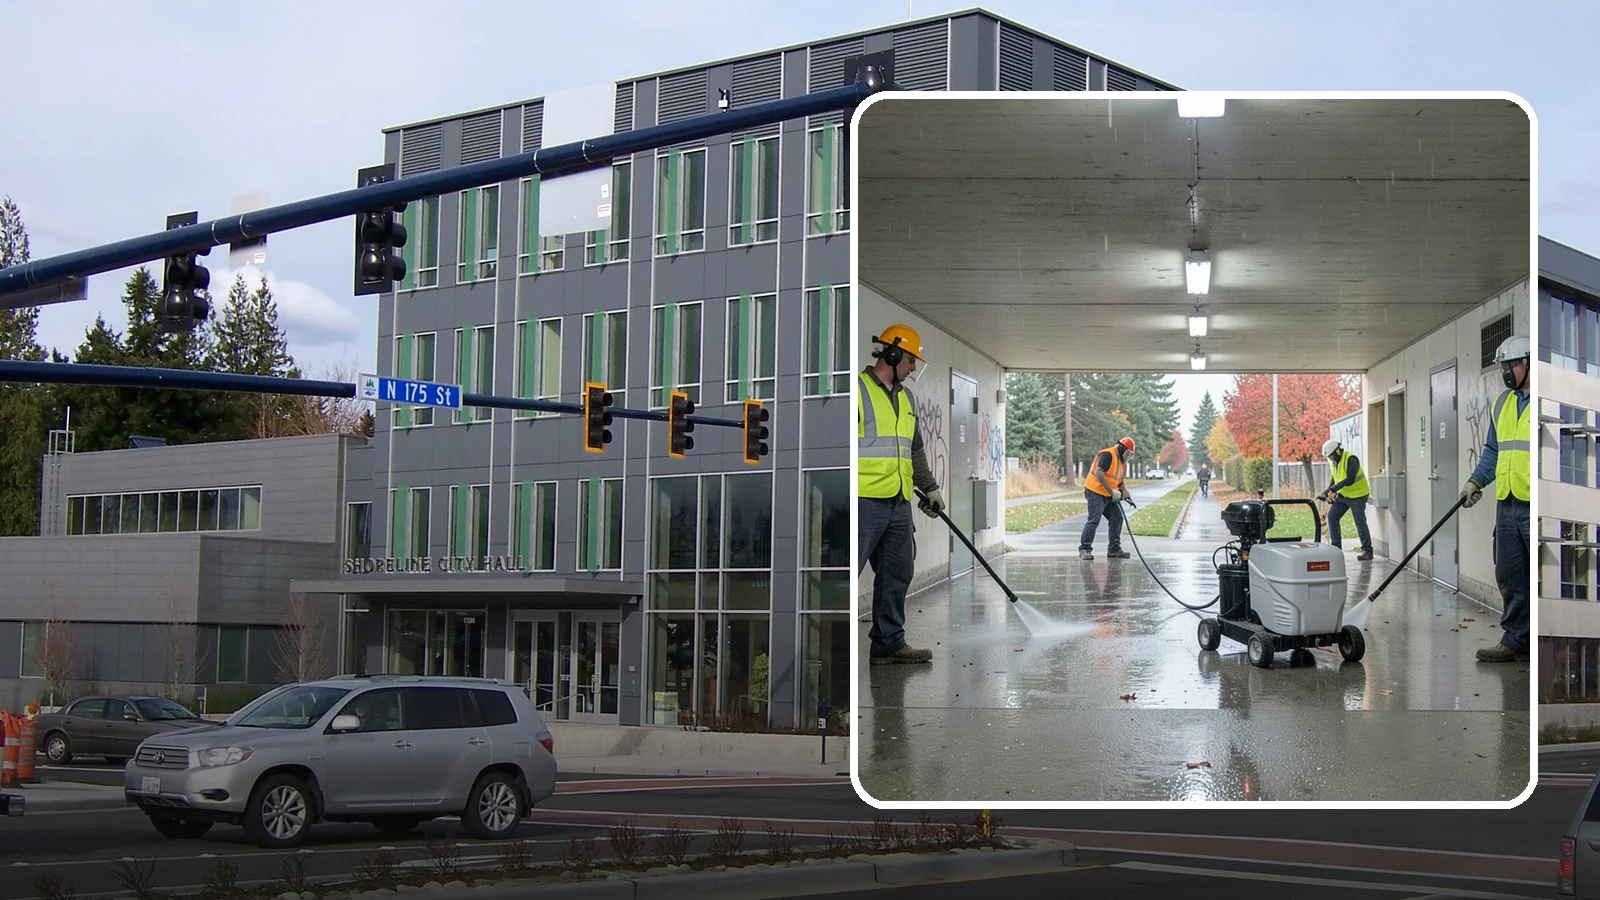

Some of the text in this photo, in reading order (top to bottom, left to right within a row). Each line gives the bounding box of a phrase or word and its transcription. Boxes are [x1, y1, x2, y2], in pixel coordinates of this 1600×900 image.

[387, 380, 451, 406] N 175 St
[344, 555, 525, 573] SHORELINE CITY HALL
